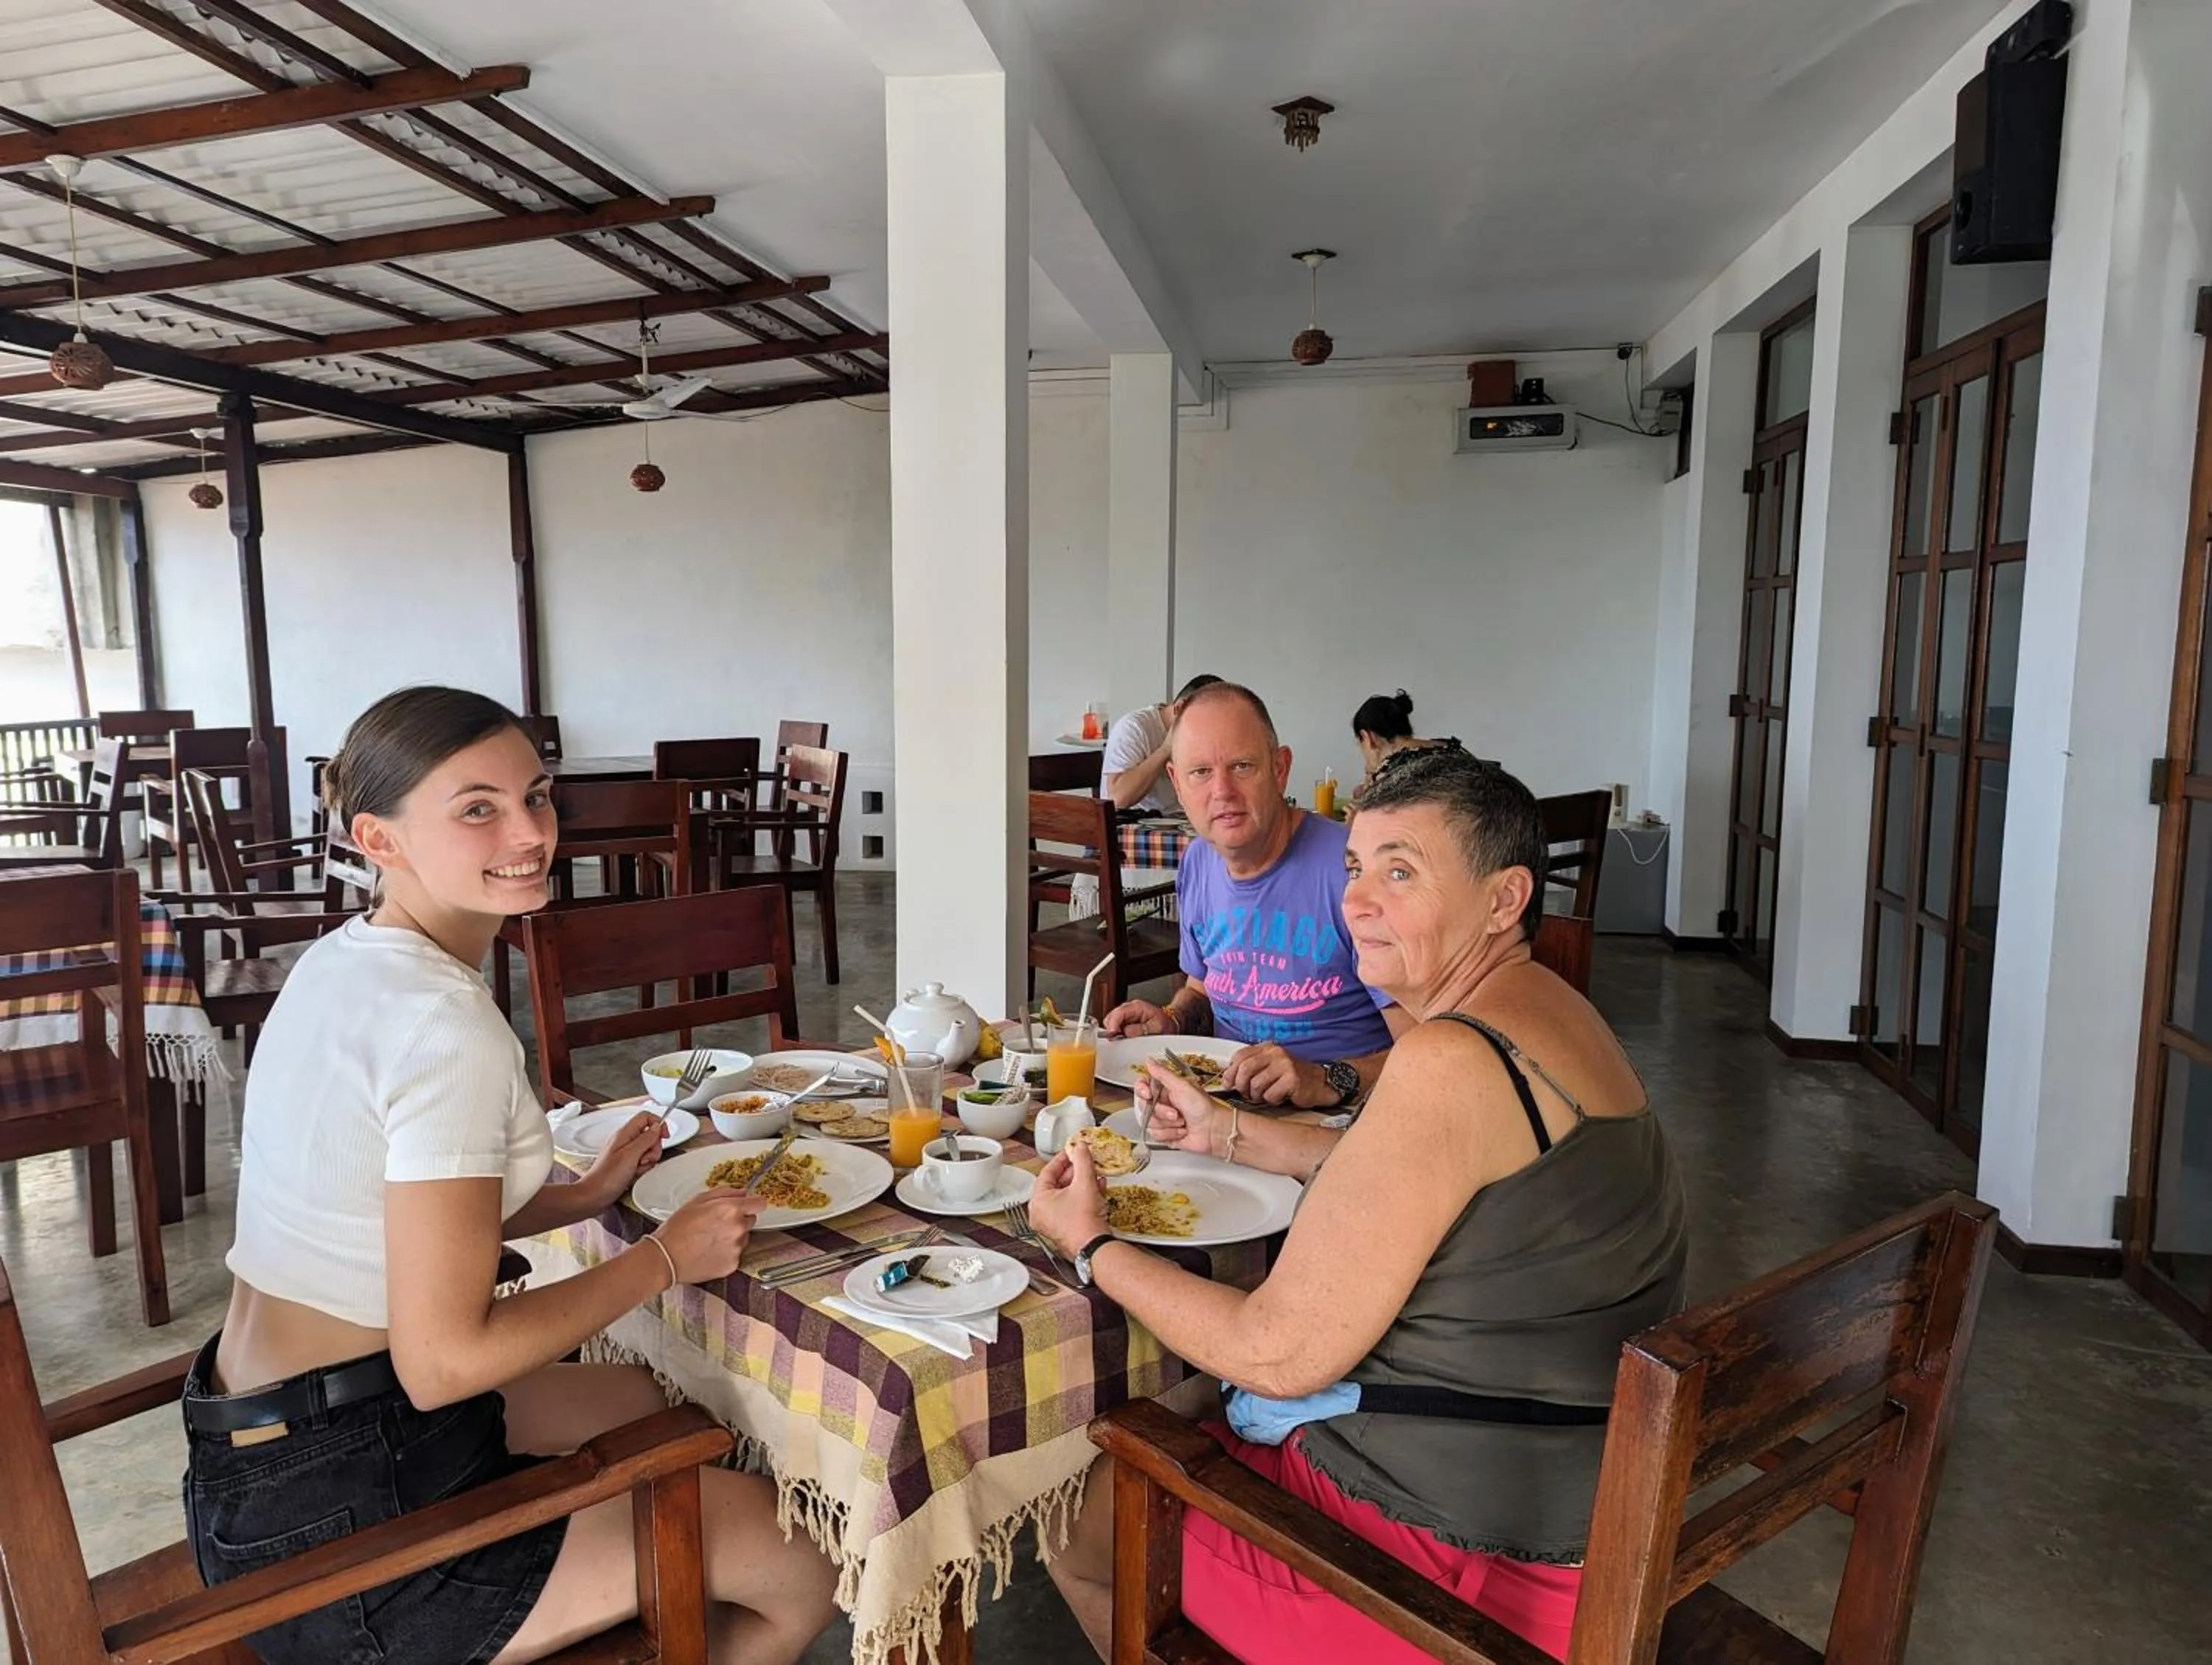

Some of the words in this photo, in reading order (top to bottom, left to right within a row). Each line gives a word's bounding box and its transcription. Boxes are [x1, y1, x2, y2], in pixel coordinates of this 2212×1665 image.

[1192, 906, 1339, 964] TIAGO
[1203, 965, 1237, 995] outh
[1236, 964, 1343, 1007] America
